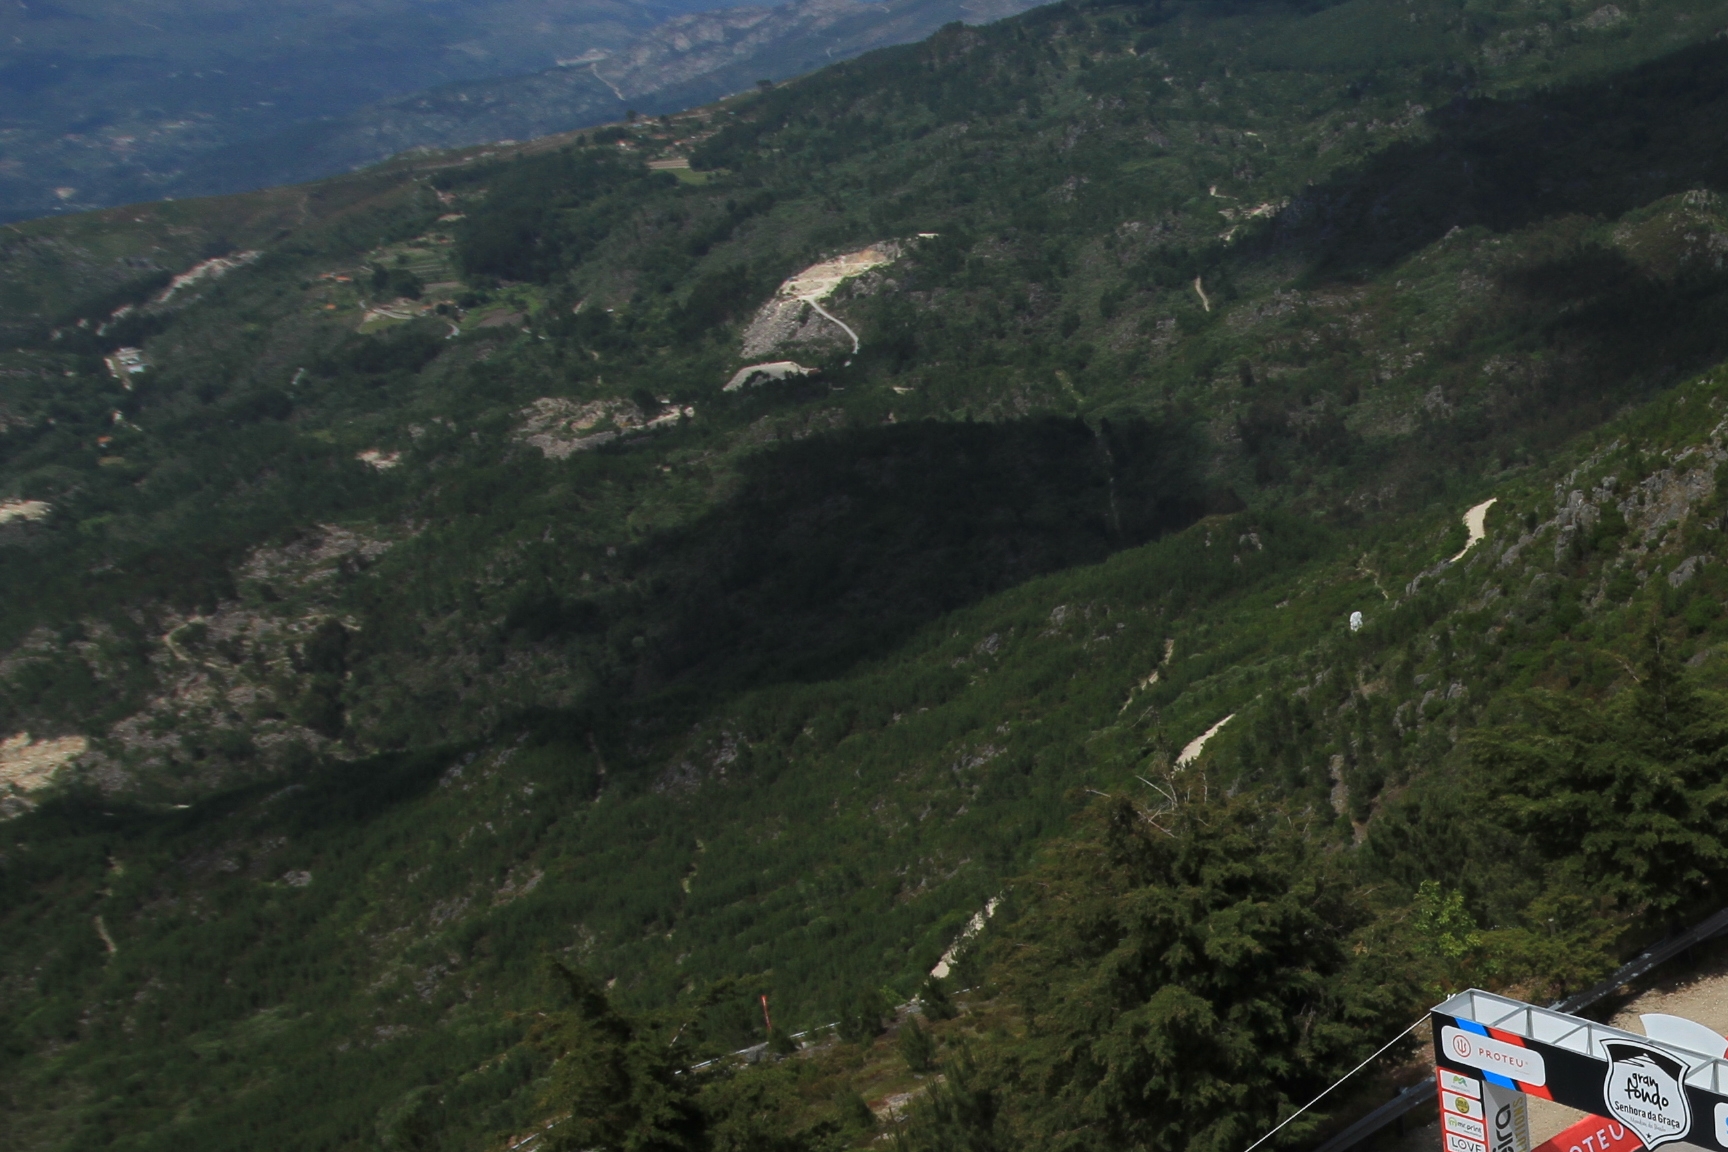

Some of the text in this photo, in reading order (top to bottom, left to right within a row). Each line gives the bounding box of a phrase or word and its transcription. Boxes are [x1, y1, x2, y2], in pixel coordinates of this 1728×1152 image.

[1478, 1048, 1524, 1068] PROTEU
[1625, 1077, 1669, 1111] fondo
[1615, 1100, 1680, 1130] Senhora da Graça
